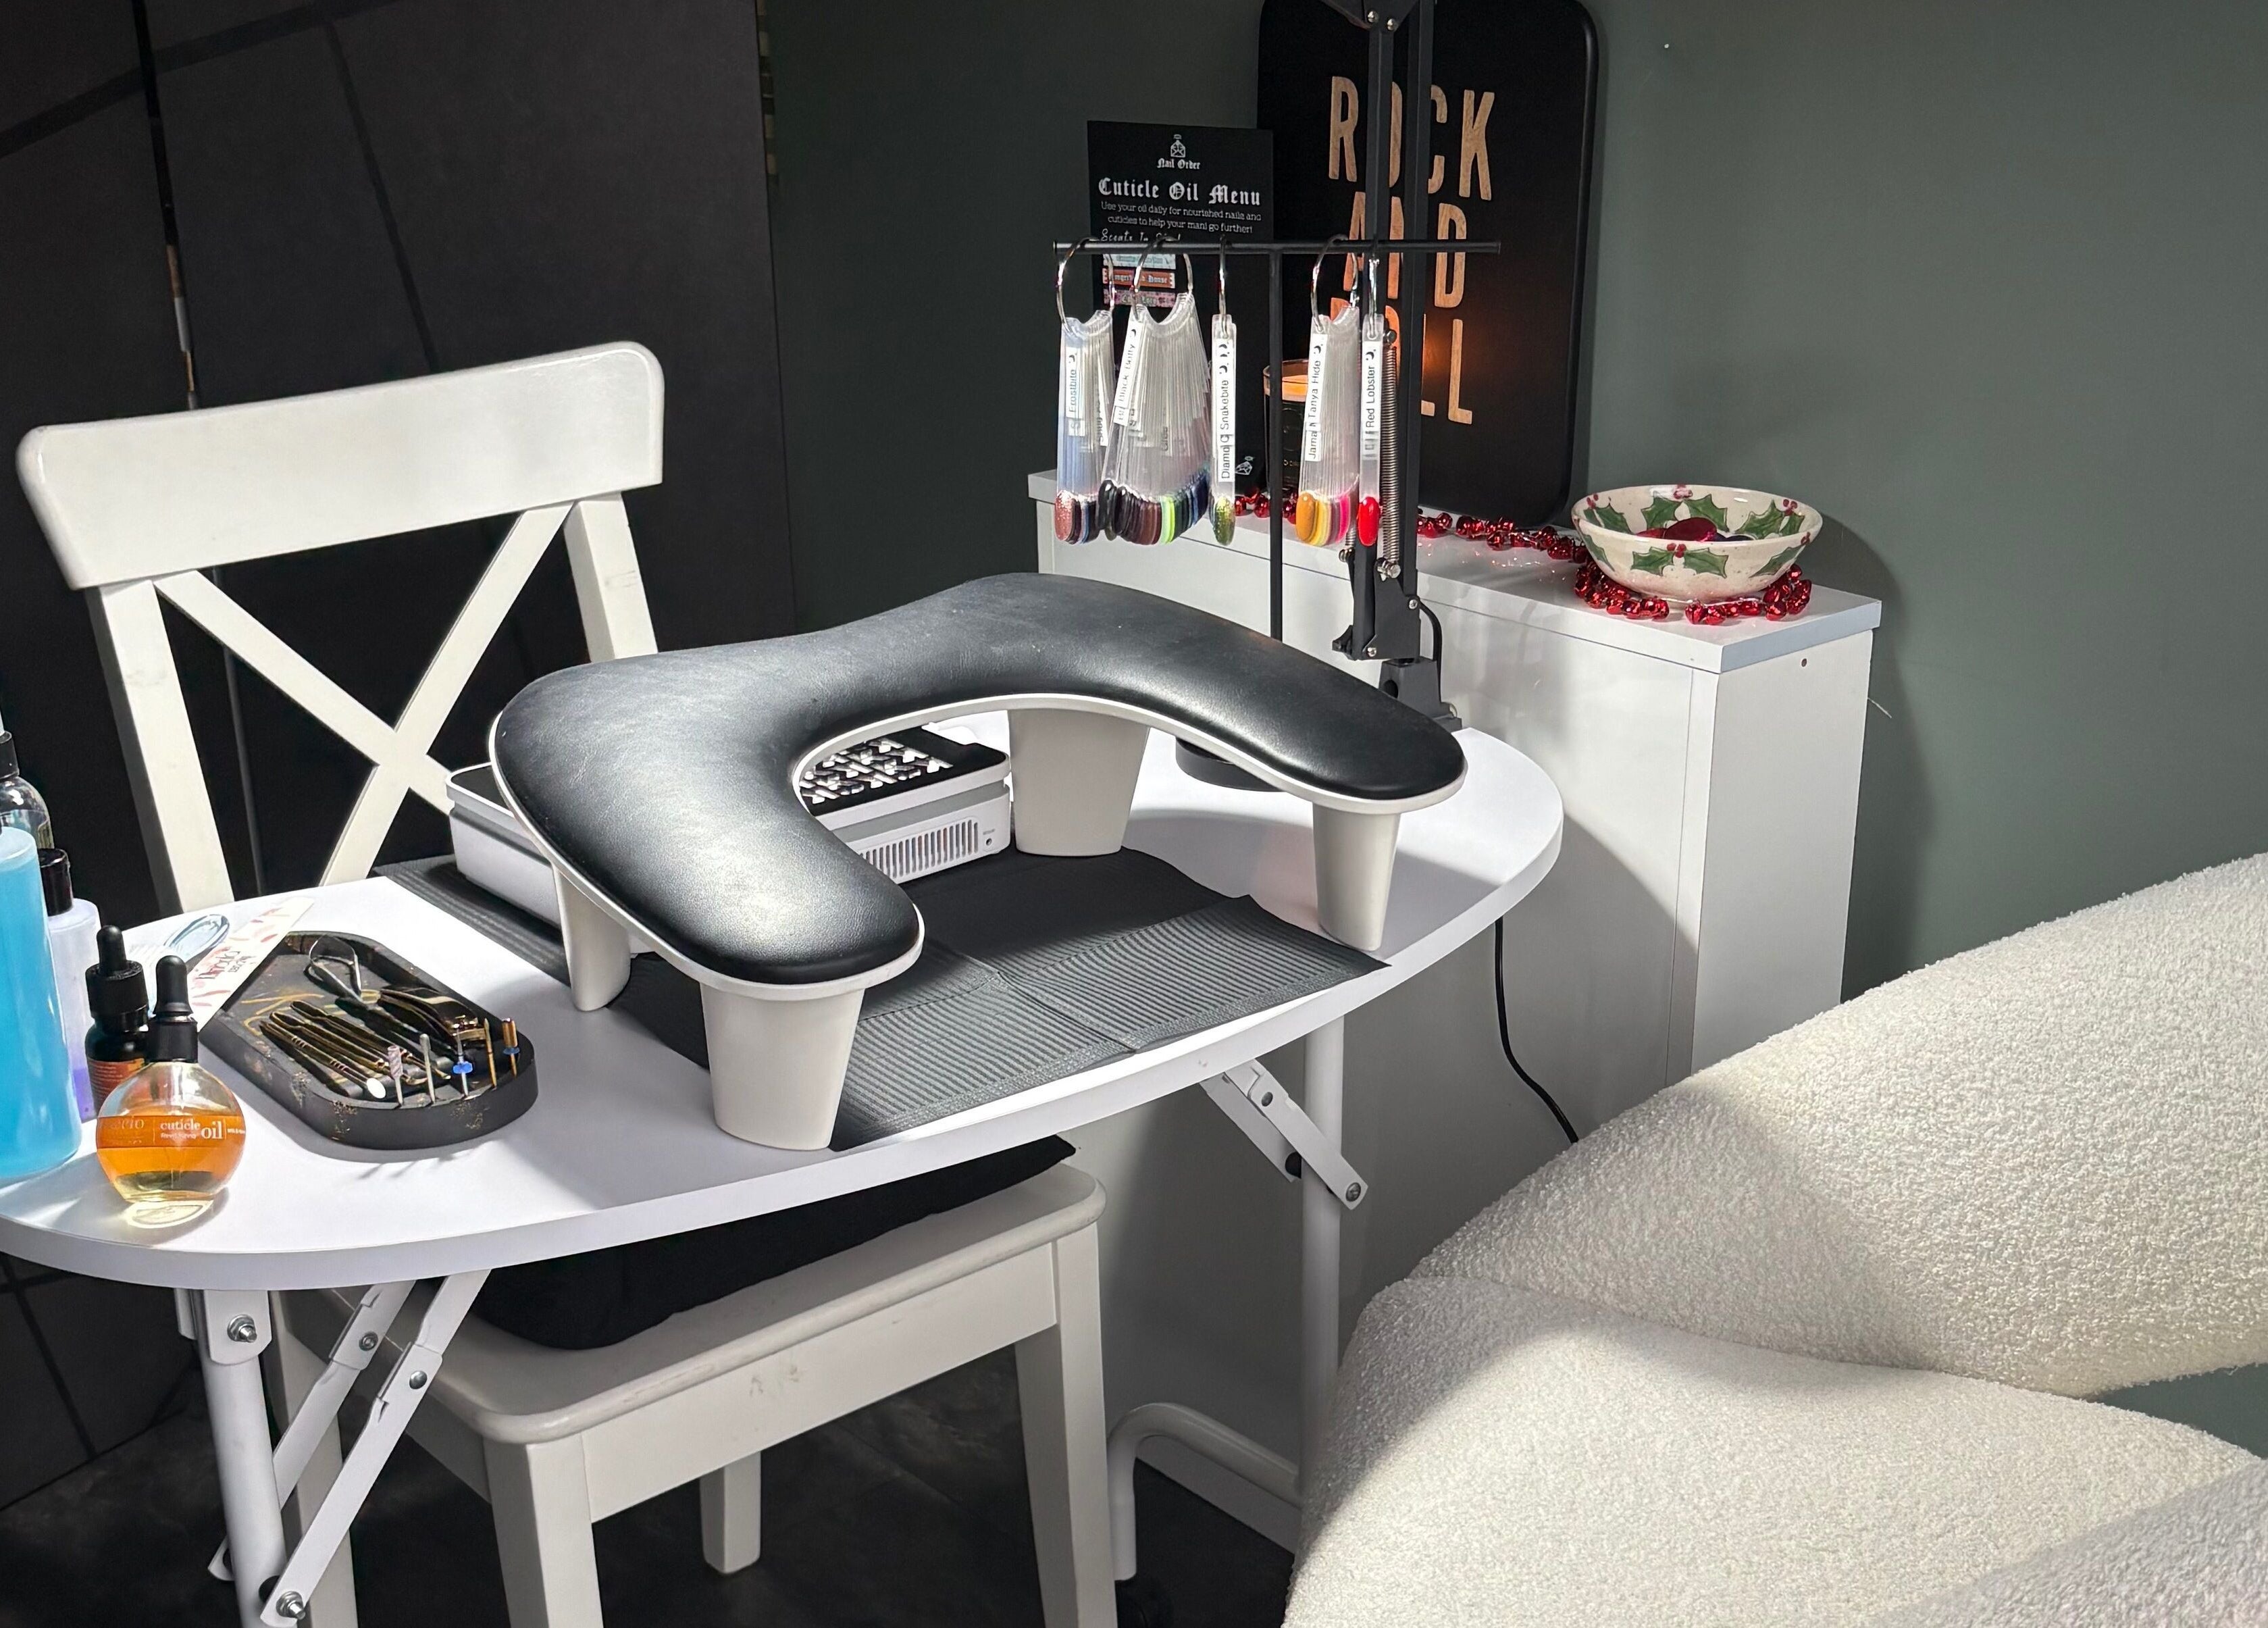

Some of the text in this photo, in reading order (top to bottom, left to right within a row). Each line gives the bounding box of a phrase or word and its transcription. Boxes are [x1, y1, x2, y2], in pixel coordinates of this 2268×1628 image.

[1156, 157, 1201, 170] Nail Order
[1098, 177, 1260, 205] Cuticle Oil Menu
[1101, 201, 1262, 221] Use your oil daily for nourished nails and
[1108, 216, 1137, 225] cuticles
[1139, 217, 1148, 225] to
[1148, 217, 1166, 228] help
[1166, 220, 1186, 229] your
[1208, 224, 1219, 232] go
[1101, 228, 1133, 241] Scents
[1139, 232, 1148, 241] In
[1118, 373, 1130, 402] Black
[1124, 343, 1137, 370] Betty
[1312, 360, 1321, 384] Hide
[1366, 365, 1375, 404] Lobster
[1068, 369, 1077, 413] Frostbite
[1308, 388, 1318, 418] Tanya
[1220, 379, 1229, 430] Snakebite
[1366, 408, 1375, 428] Red
[1221, 446, 1231, 479] Diamo
[160, 1118, 201, 1130] cuticle
[201, 1121, 223, 1140] oil
